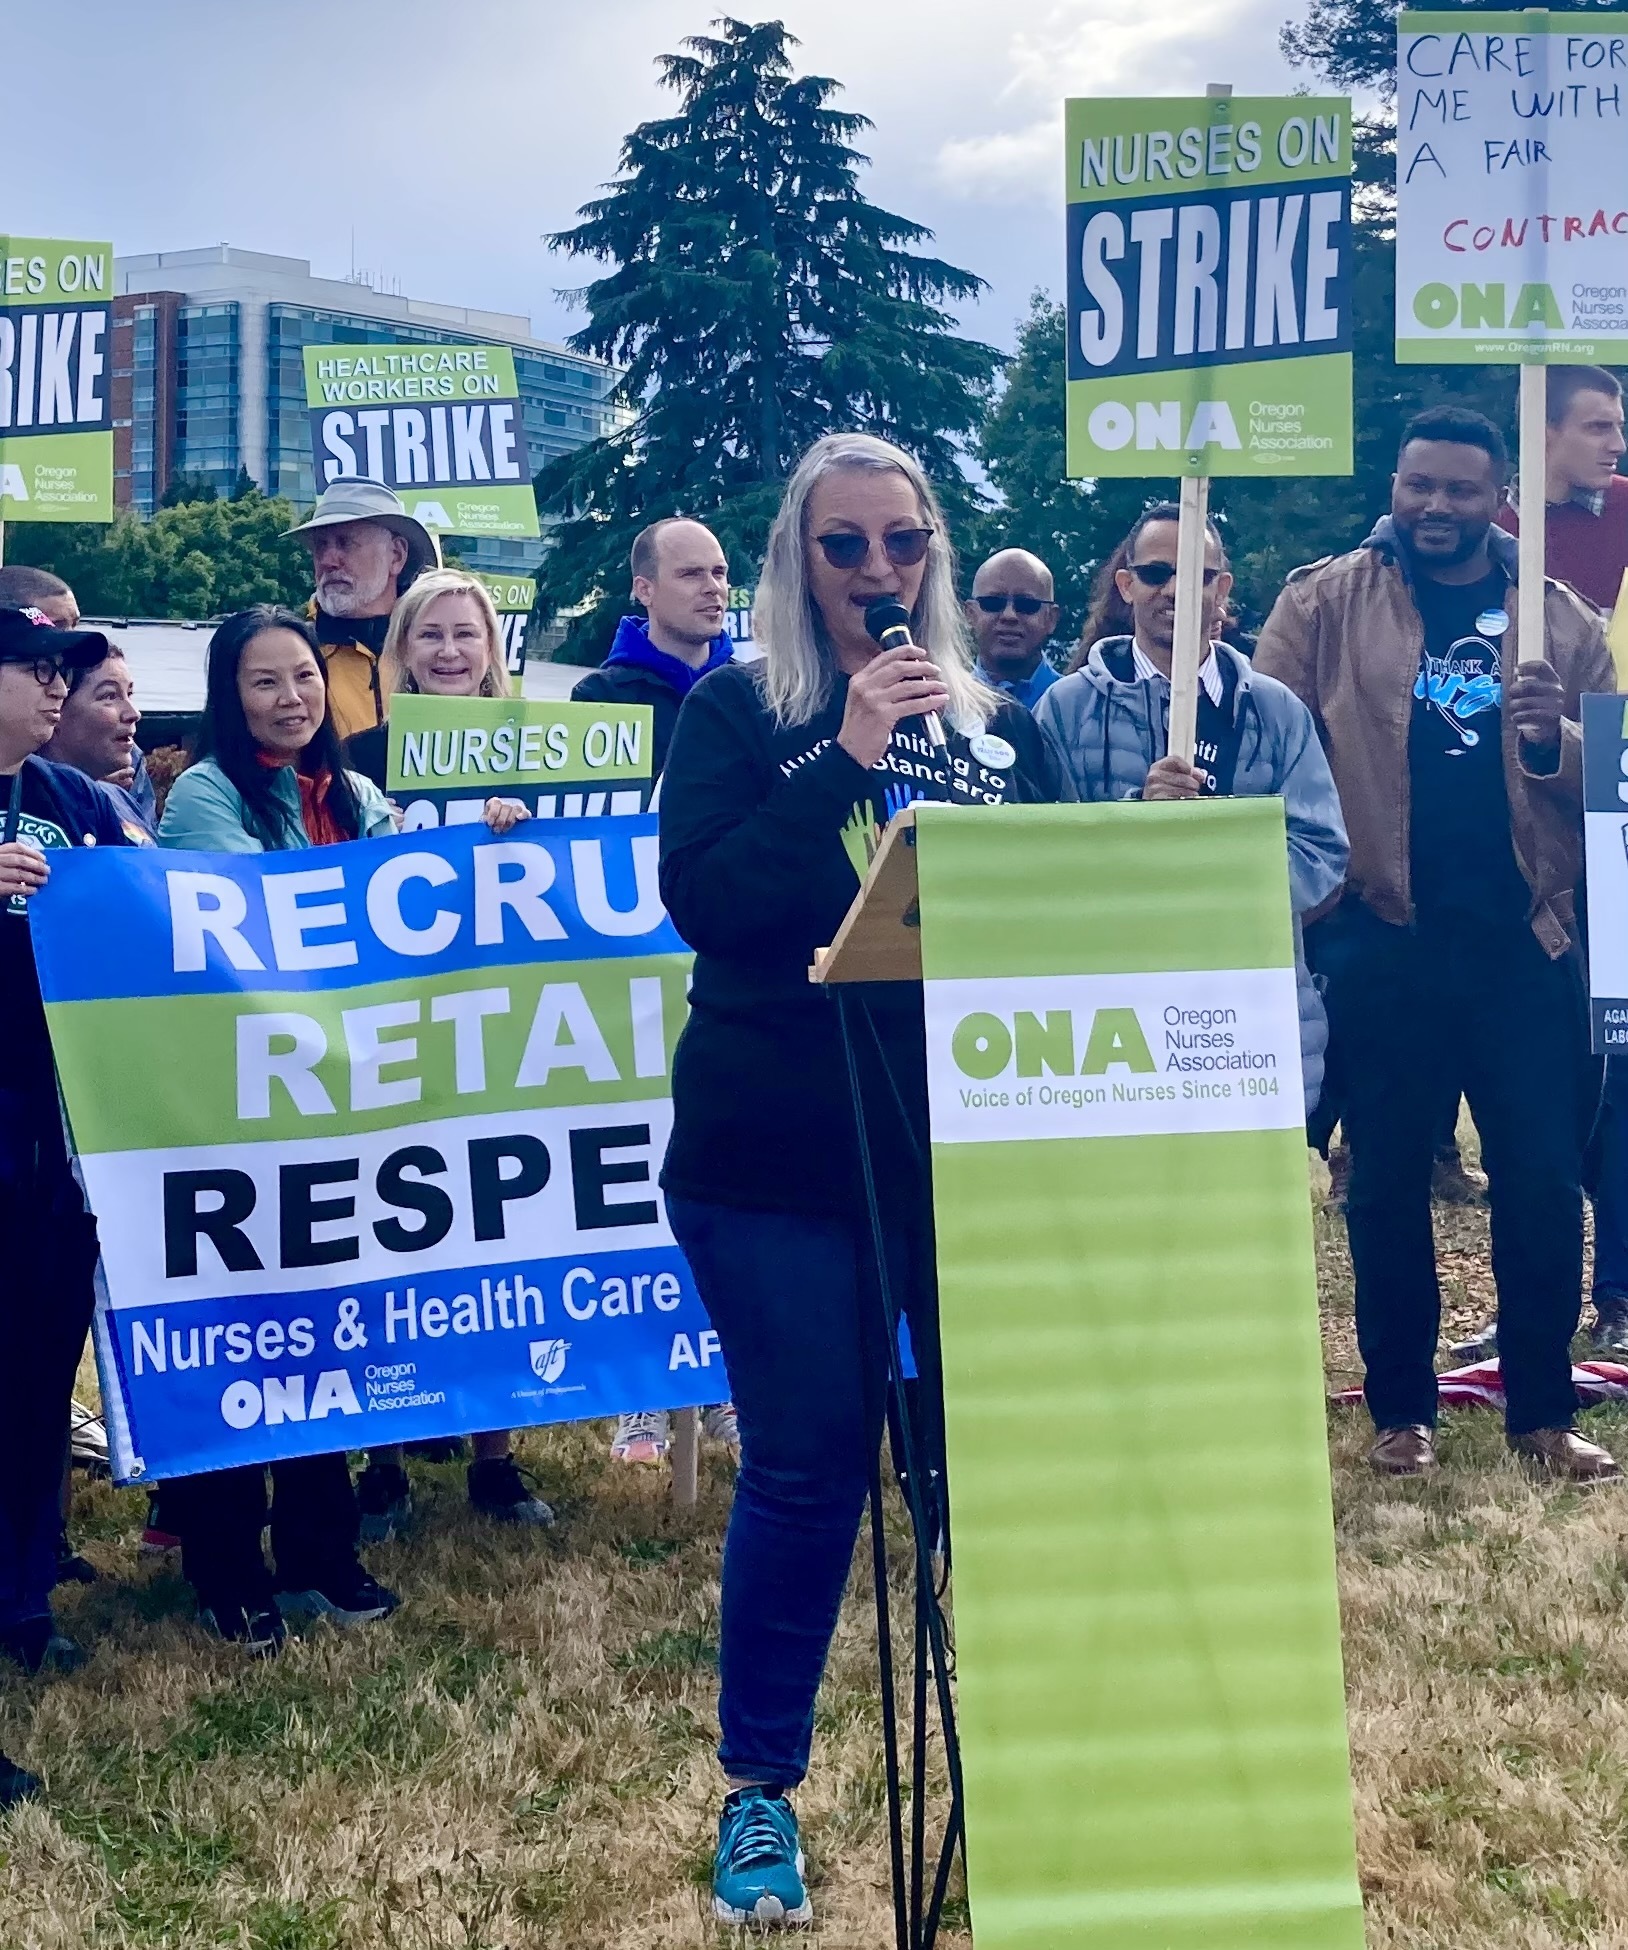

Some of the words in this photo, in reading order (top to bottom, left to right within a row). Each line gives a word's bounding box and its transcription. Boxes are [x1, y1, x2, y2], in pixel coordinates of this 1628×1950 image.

[1407, 32, 1535, 77] CARE
[1566, 36, 1628, 71] FOR
[1409, 88, 1471, 130] ME
[1512, 84, 1620, 117] WITH
[1080, 121, 1262, 188] NURSES
[1278, 113, 1340, 168] ON
[1406, 142, 1446, 184] A
[1485, 139, 1552, 174] FAIR
[1443, 209, 1628, 252] CONTRAC
[0, 256, 47, 295] ES
[58, 254, 105, 293] ON
[1079, 191, 1342, 367] STRIKE
[1413, 282, 1565, 329] ONA
[1572, 283, 1627, 301] Oregon
[1572, 300, 1624, 315] Nurses
[1474, 341, 1595, 357] www.OregonRN.org
[317, 351, 489, 379] HEALTHCARE
[322, 375, 455, 402] WORKERS
[462, 374, 500, 394] ON
[1249, 401, 1305, 417] Oregon
[1088, 400, 1242, 451] ONA
[1249, 420, 1302, 433] Nurses
[322, 404, 521, 484] STRIKE
[1249, 434, 1333, 450] Association
[34, 464, 77, 478] Oregon
[34, 478, 75, 491] Nurses
[33, 490, 98, 503] Association
[401, 501, 455, 529] A
[507, 584, 531, 605] ON
[1430, 658, 1483, 675] THANK
[401, 722, 569, 778] NURSES
[583, 720, 642, 767] ON
[979, 768, 1007, 790] to
[165, 836, 668, 972] RECRU
[1163, 1005, 1237, 1029] Oregon
[1604, 1009, 1628, 1024] AGA
[235, 973, 694, 1120] RETAI
[952, 1007, 1158, 1080] ONA
[1165, 1029, 1236, 1050] Nurses
[1604, 1028, 1628, 1044] LAB
[1165, 1049, 1277, 1073] Association
[959, 1087, 1010, 1109] Voice
[1016, 1086, 1034, 1106] of
[1038, 1085, 1106, 1109] Oregon
[1112, 1082, 1177, 1103] Nurses
[1182, 1079, 1232, 1099] Since
[1237, 1076, 1280, 1097] 1904
[163, 1124, 659, 1279] RESPE
[131, 1317, 316, 1376] Nurses
[333, 1297, 369, 1351] &
[385, 1274, 545, 1343] Health
[562, 1266, 682, 1321] Care
[365, 1361, 417, 1381] Oregon
[534, 1337, 574, 1379] aft
[221, 1369, 363, 1430] ONA
[366, 1378, 416, 1397] Nurses
[367, 1389, 446, 1413] Association
